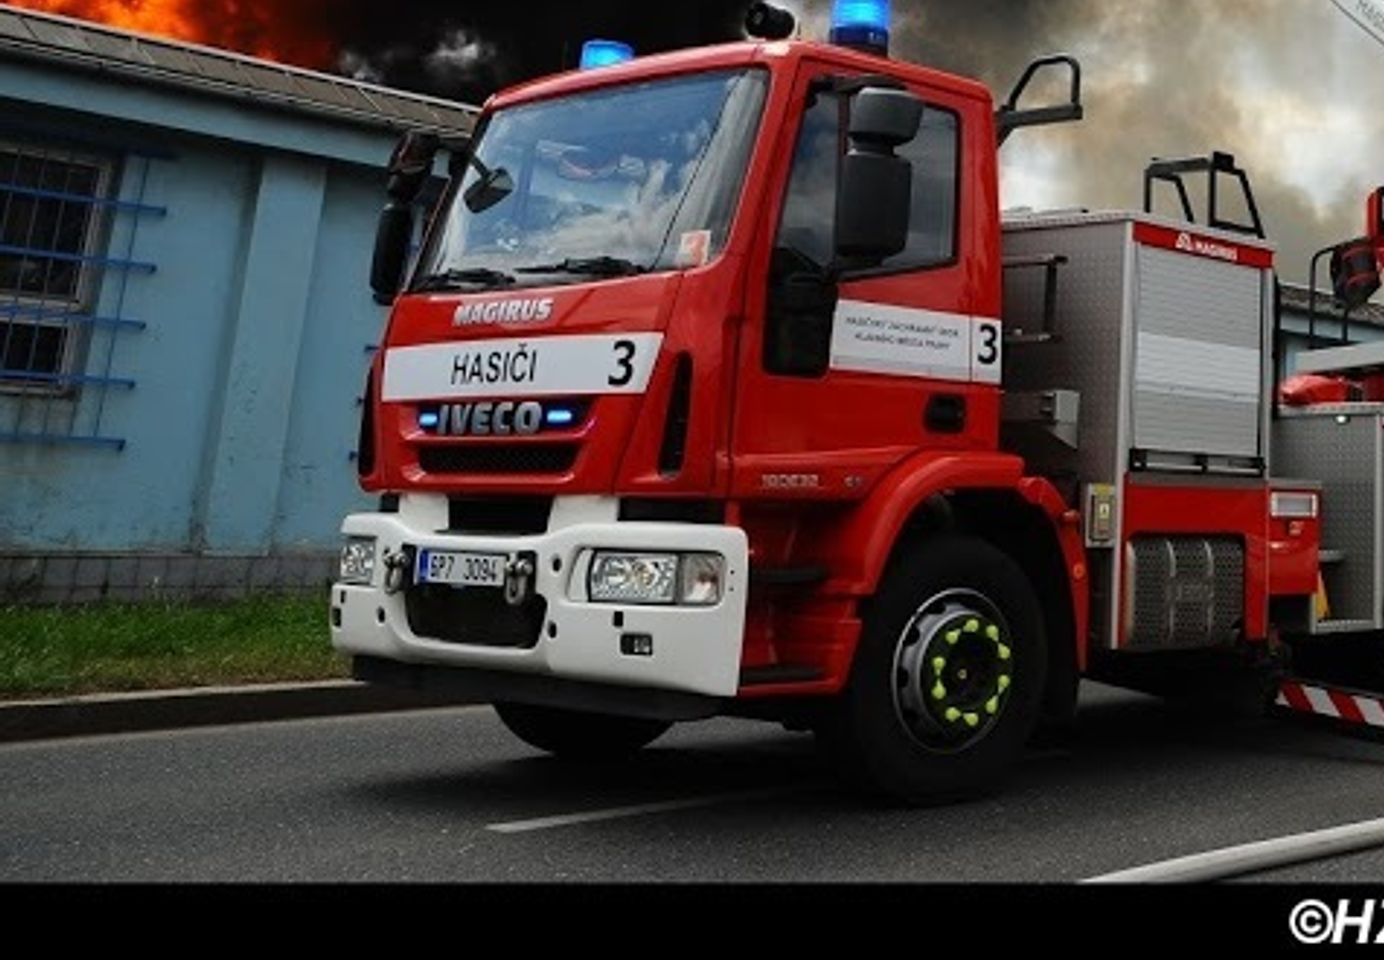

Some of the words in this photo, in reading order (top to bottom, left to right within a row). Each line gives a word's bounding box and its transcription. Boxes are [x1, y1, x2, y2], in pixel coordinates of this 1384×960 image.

[454, 298, 553, 326] MAGIRUS
[450, 342, 538, 385] HASIČI
[607, 340, 637, 386] 3
[977, 324, 998, 364] 3
[437, 401, 542, 435] IVECO
